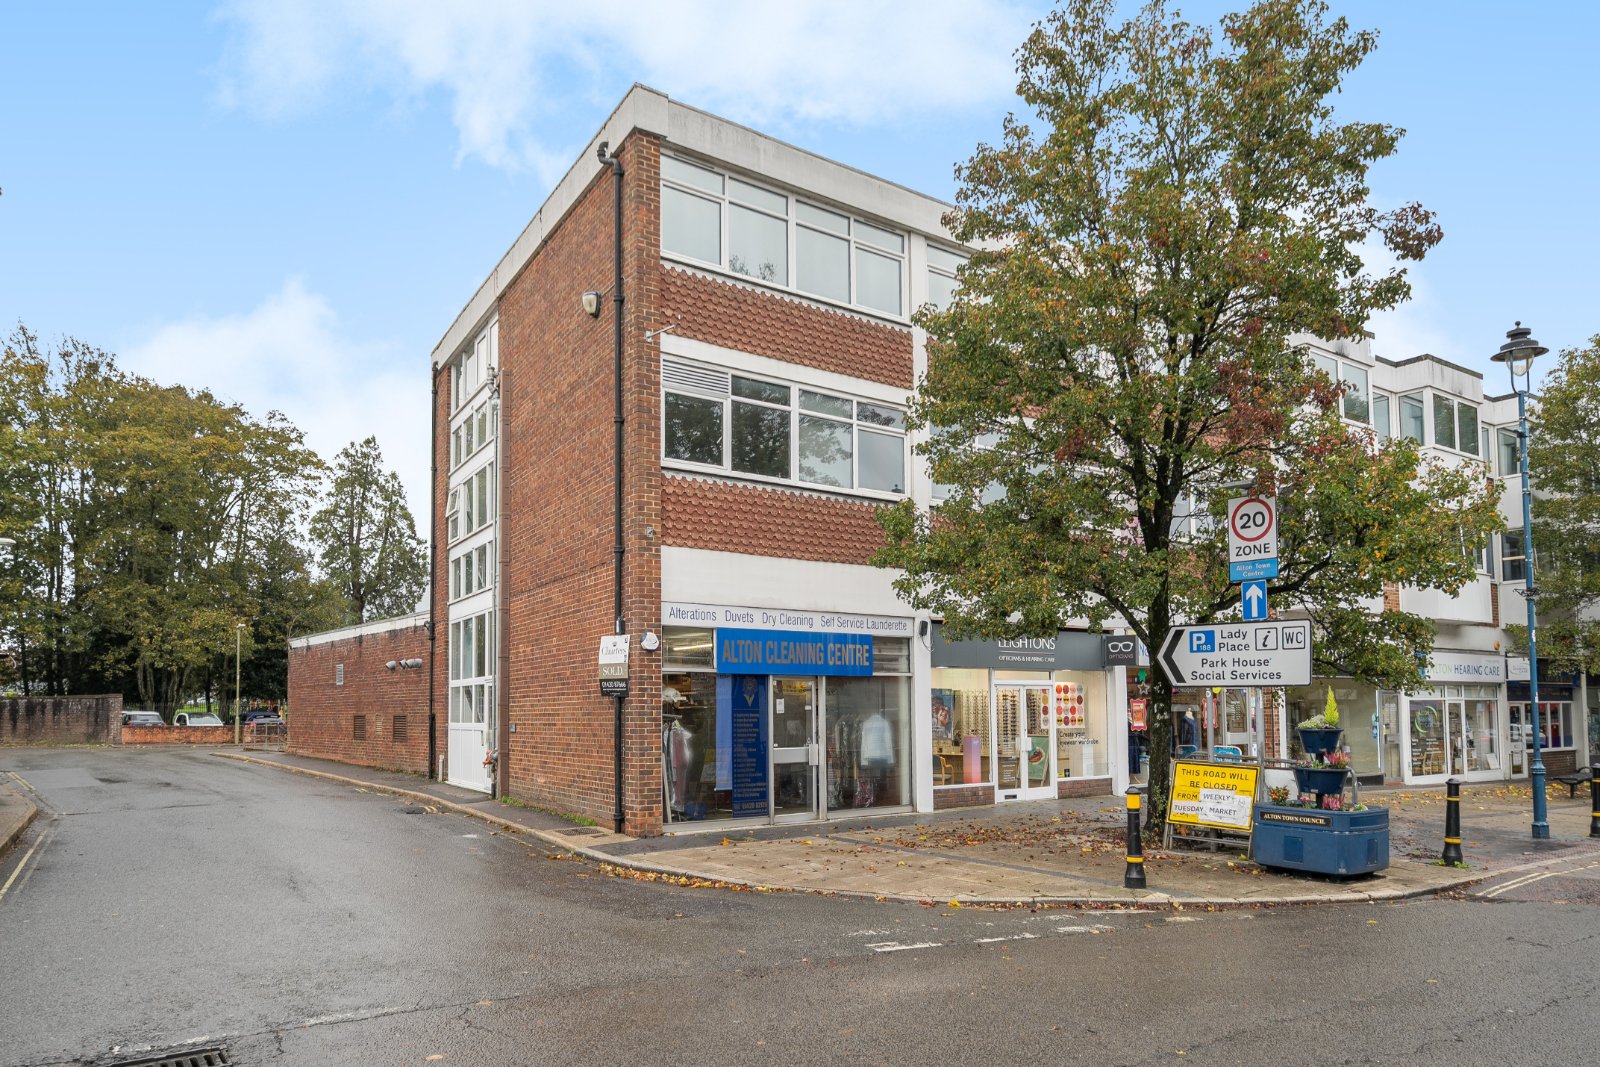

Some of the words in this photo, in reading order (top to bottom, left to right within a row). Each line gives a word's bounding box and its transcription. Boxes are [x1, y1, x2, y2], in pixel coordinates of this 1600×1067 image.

[1239, 511, 1266, 530] 20
[1236, 542, 1270, 557] ZONE
[1236, 563, 1253, 572] Alton
[1254, 562, 1271, 570] Town
[668, 606, 717, 621] Alterations
[725, 610, 754, 623] Duvets
[762, 612, 777, 627] Dry
[780, 613, 814, 628] Cleaning
[820, 615, 836, 628] Self
[837, 616, 864, 629] Service
[866, 618, 908, 631] Launderette
[1192, 633, 1205, 651] P
[1220, 629, 1248, 640] Lady
[1285, 632, 1303, 644] WC
[602, 646, 627, 656] Charters
[1218, 642, 1250, 652] Place
[722, 640, 762, 664] ALTON
[766, 642, 824, 665] CLEANING
[828, 644, 870, 666] CENTRE
[1201, 656, 1227, 668] Park
[1232, 656, 1270, 667] House
[602, 666, 623, 676] SOLD
[1191, 670, 1225, 680] Social
[1230, 670, 1282, 680] Services
[1454, 665, 1483, 676] HEARING
[1484, 666, 1500, 676] CARE
[1182, 768, 1200, 776] THIS
[1203, 770, 1226, 779] ROAD
[1229, 772, 1249, 780] WILL
[1203, 782, 1237, 791] CLOSED
[1209, 807, 1236, 816] MARKET
